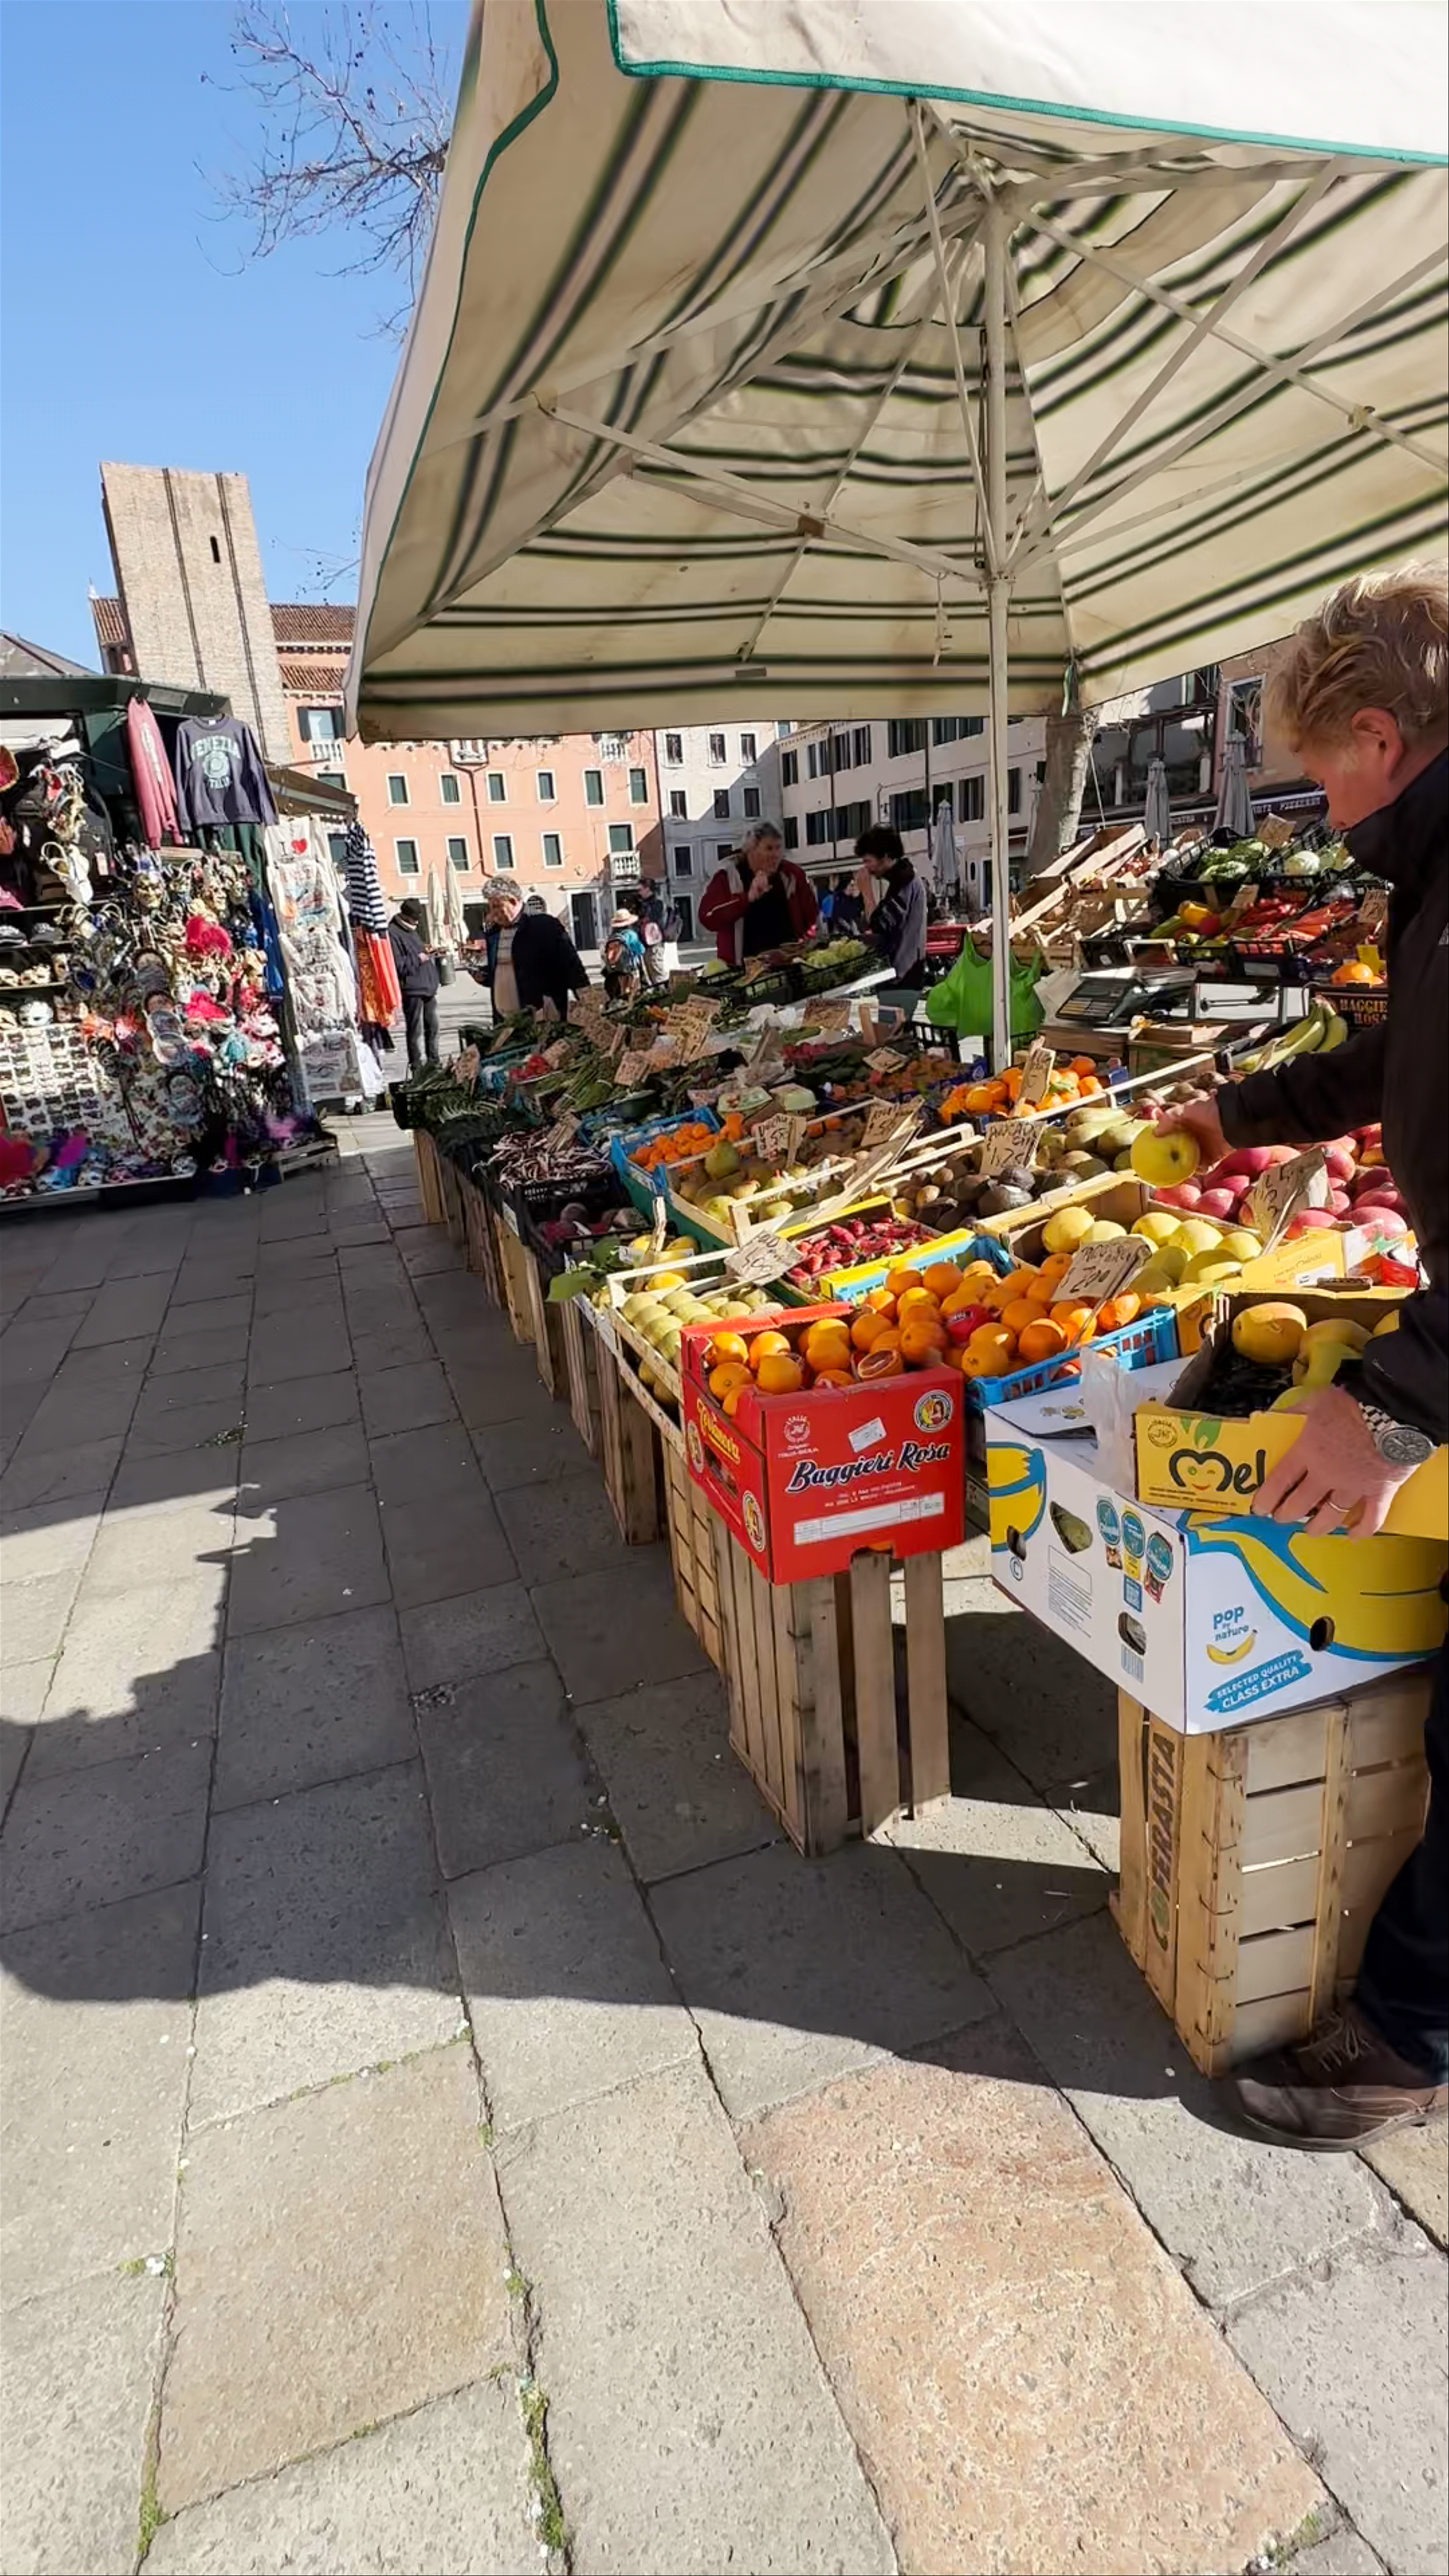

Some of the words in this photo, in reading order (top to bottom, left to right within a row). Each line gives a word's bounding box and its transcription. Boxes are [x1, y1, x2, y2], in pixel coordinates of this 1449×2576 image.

[786, 1451, 894, 1493] Baggieri
[897, 1441, 951, 1472] Rosa
[1213, 1606, 1244, 1630] pop
[1215, 1625, 1249, 1641] nature
[1217, 1673, 1259, 1698] SELECTED
[1261, 1656, 1297, 1677] QUALITY
[1223, 1684, 1259, 1708] CLASS
[1261, 1666, 1299, 1690] EXTRA
